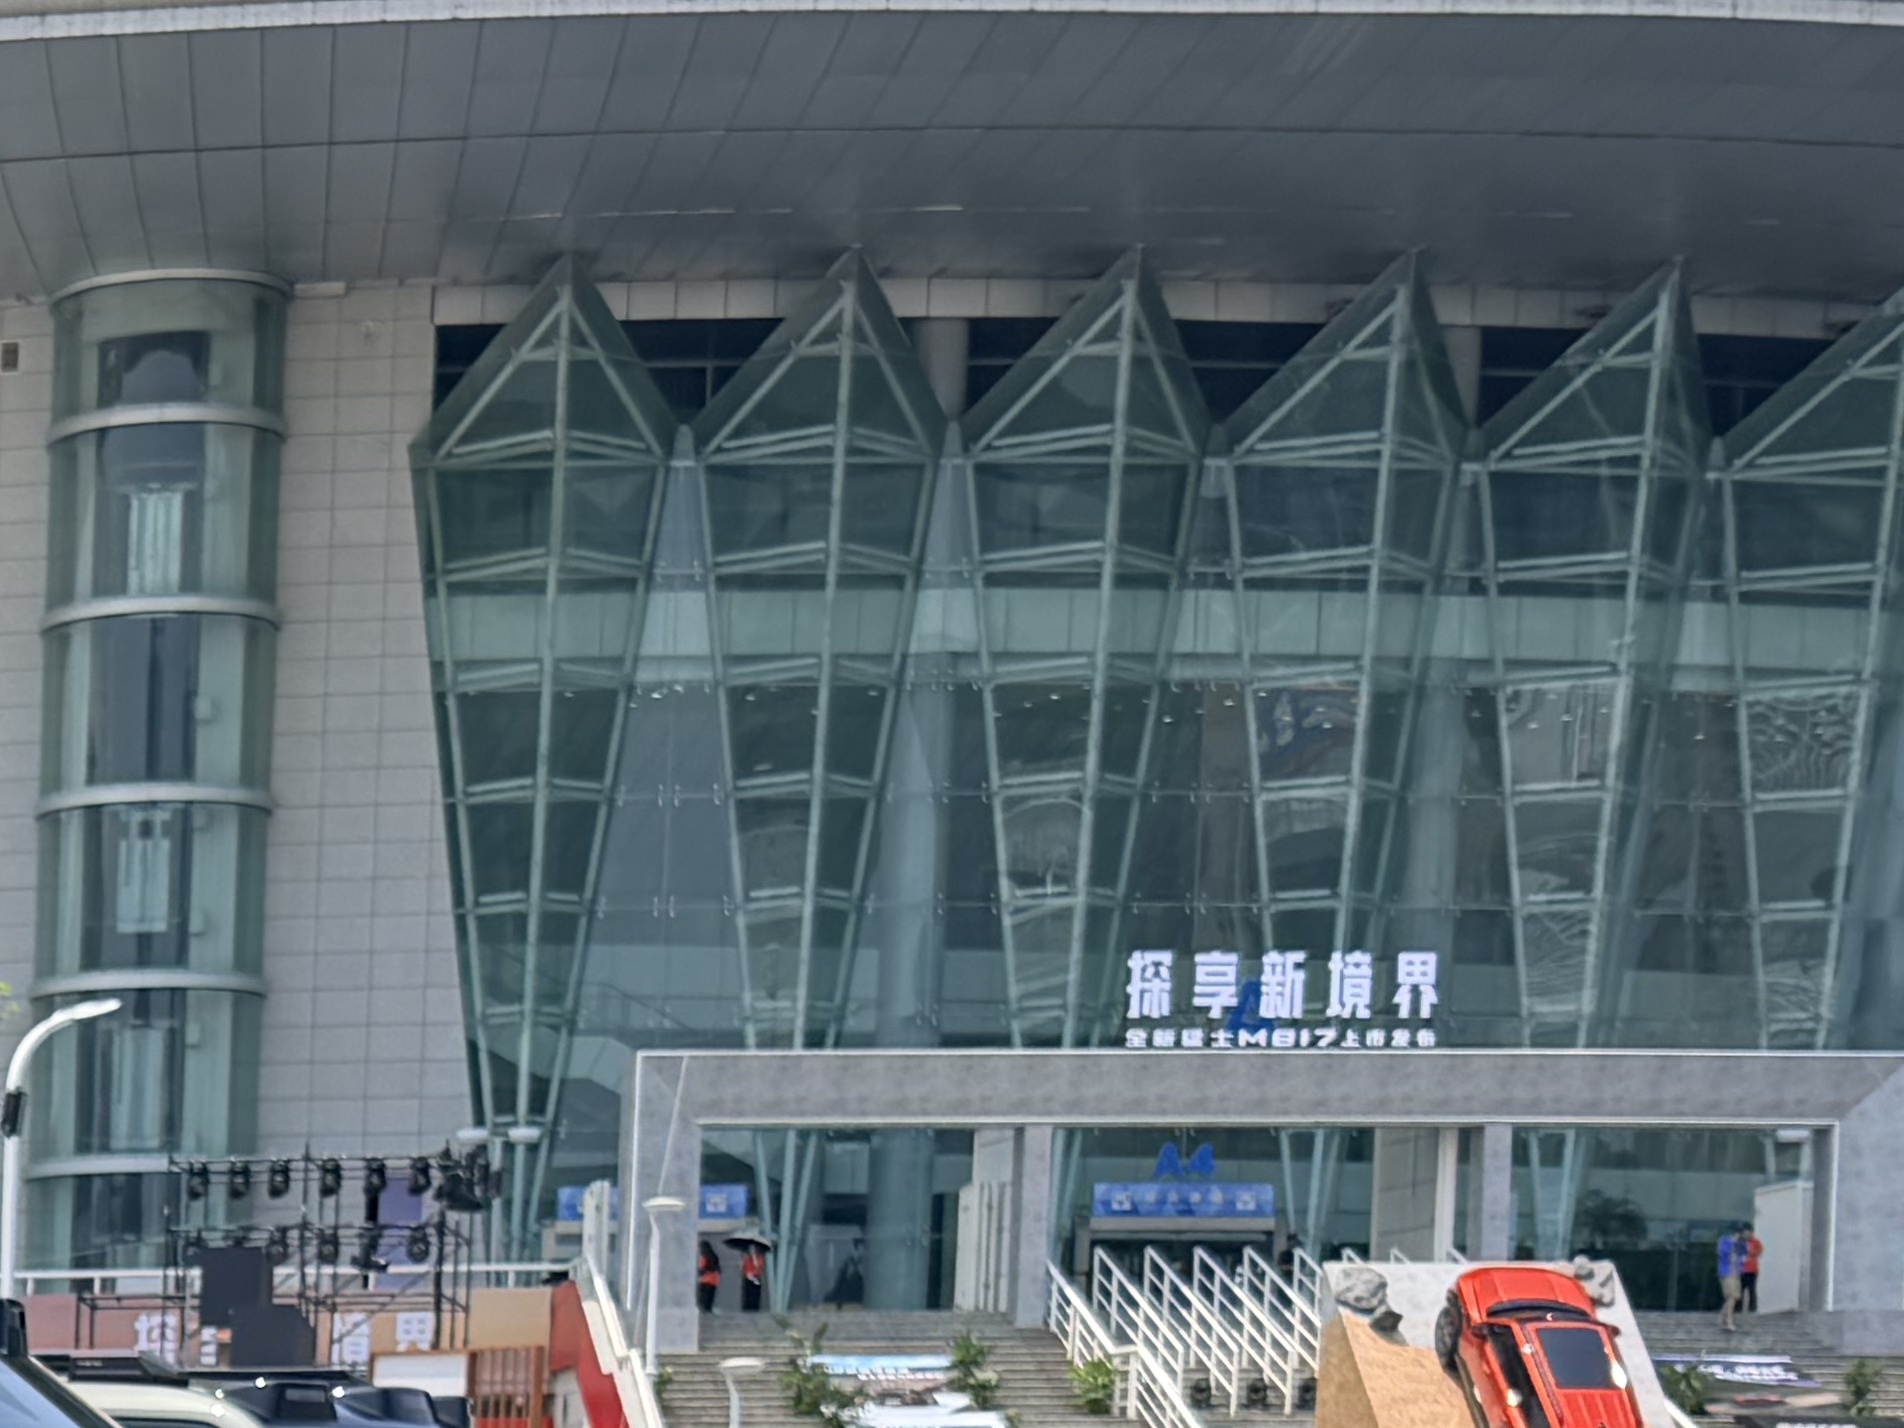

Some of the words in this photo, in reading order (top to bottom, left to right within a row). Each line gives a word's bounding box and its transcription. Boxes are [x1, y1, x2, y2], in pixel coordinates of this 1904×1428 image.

[1125, 949, 1439, 1019] 探享新境界
